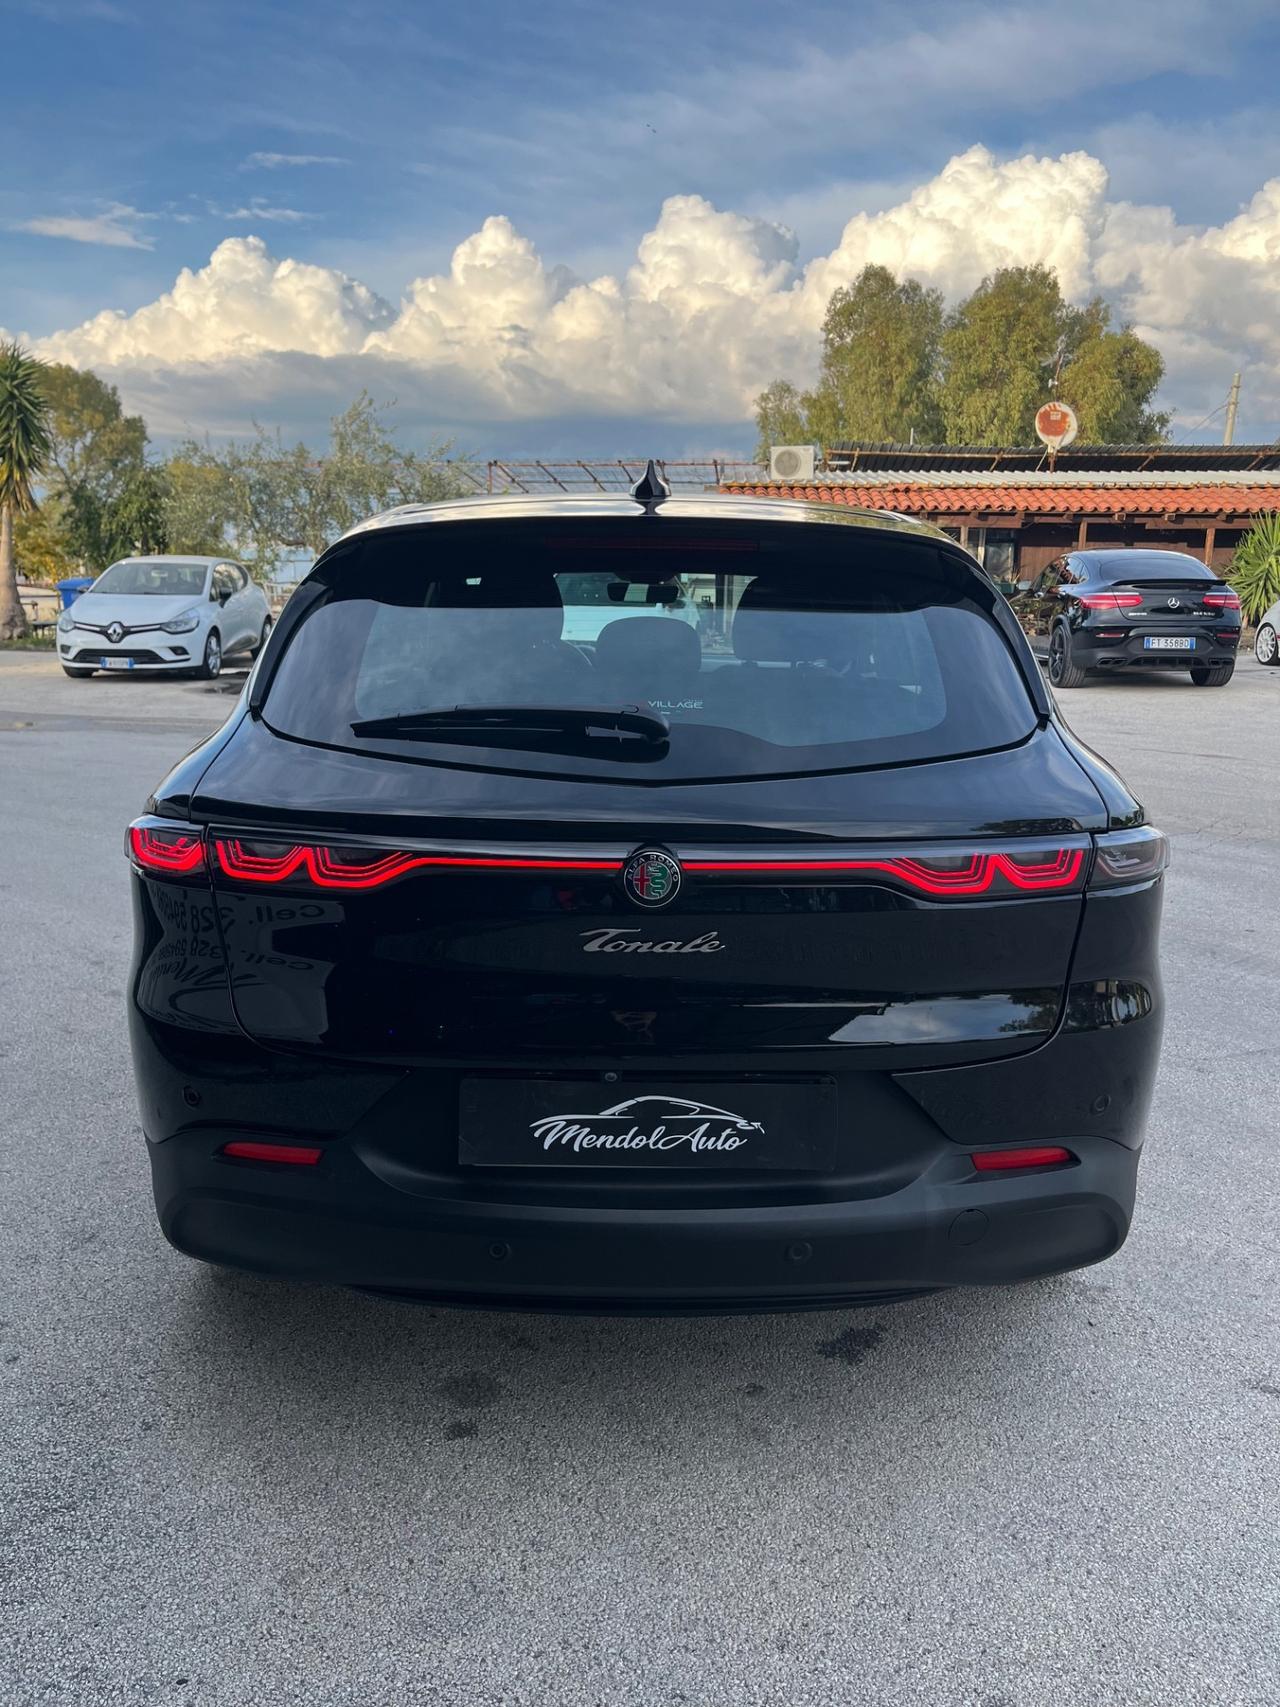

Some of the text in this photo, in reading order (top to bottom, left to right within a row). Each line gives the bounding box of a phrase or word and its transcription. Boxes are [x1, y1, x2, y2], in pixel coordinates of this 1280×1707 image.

[1151, 638, 1161, 647] FT
[648, 700, 704, 709] VILLAGE
[627, 854, 679, 882] ALFA ROMEO
[579, 928, 725, 953] Tonale
[533, 1120, 748, 1153] MendolAuto
